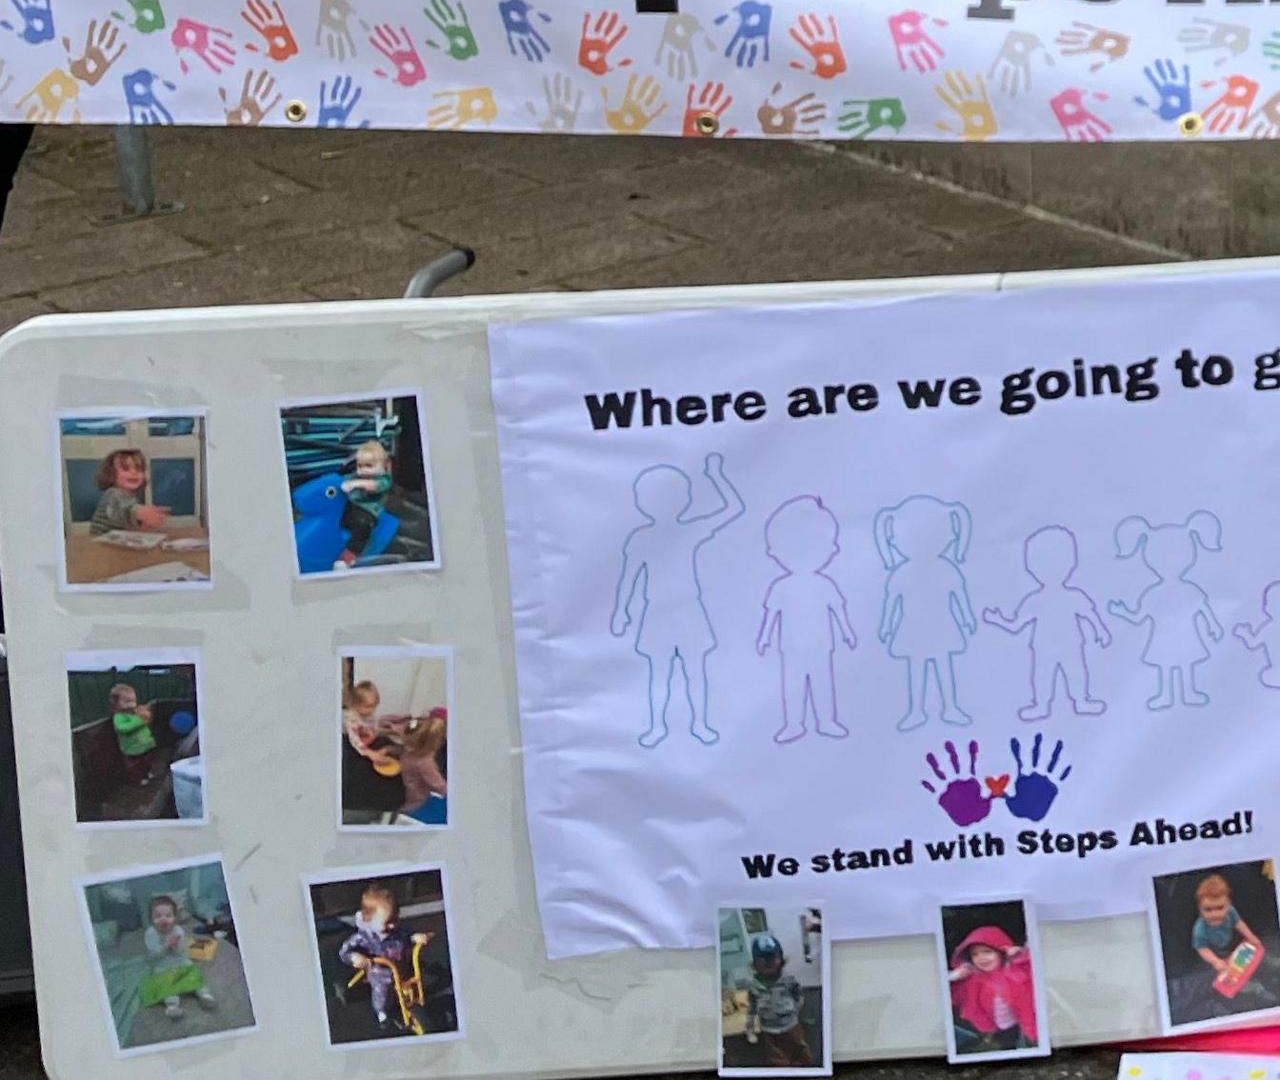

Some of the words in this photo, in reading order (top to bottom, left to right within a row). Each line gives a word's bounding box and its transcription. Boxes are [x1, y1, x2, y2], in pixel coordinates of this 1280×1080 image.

[583, 387, 768, 431] Where
[785, 381, 880, 419] are
[896, 376, 983, 410] we
[999, 357, 1160, 416] going
[1174, 348, 1235, 389] to
[740, 853, 801, 880] We
[810, 838, 914, 874] stand
[924, 831, 1006, 862] with
[1016, 828, 1119, 858] Steps
[1128, 809, 1254, 847] Ahead!
